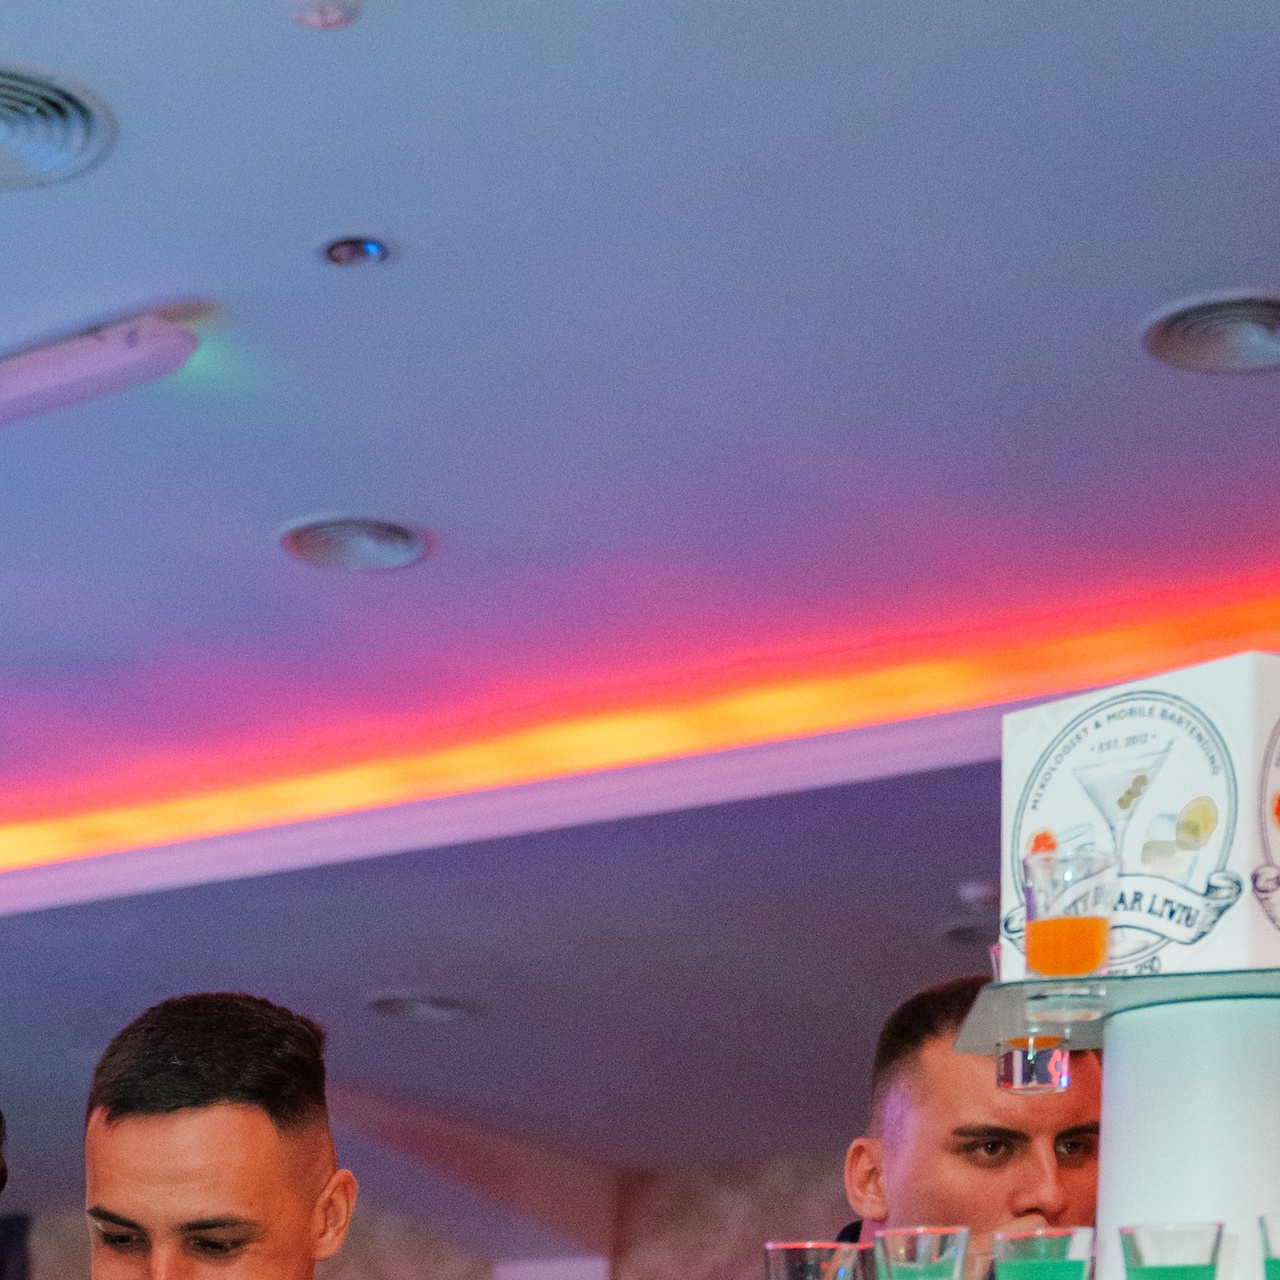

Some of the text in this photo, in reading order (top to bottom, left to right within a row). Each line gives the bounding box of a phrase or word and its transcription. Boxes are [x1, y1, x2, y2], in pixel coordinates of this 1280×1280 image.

[1031, 727, 1089, 810] MIXOLOGIST
[1107, 706, 1155, 722] MOBILE
[1160, 708, 1221, 776] BARTENDING
